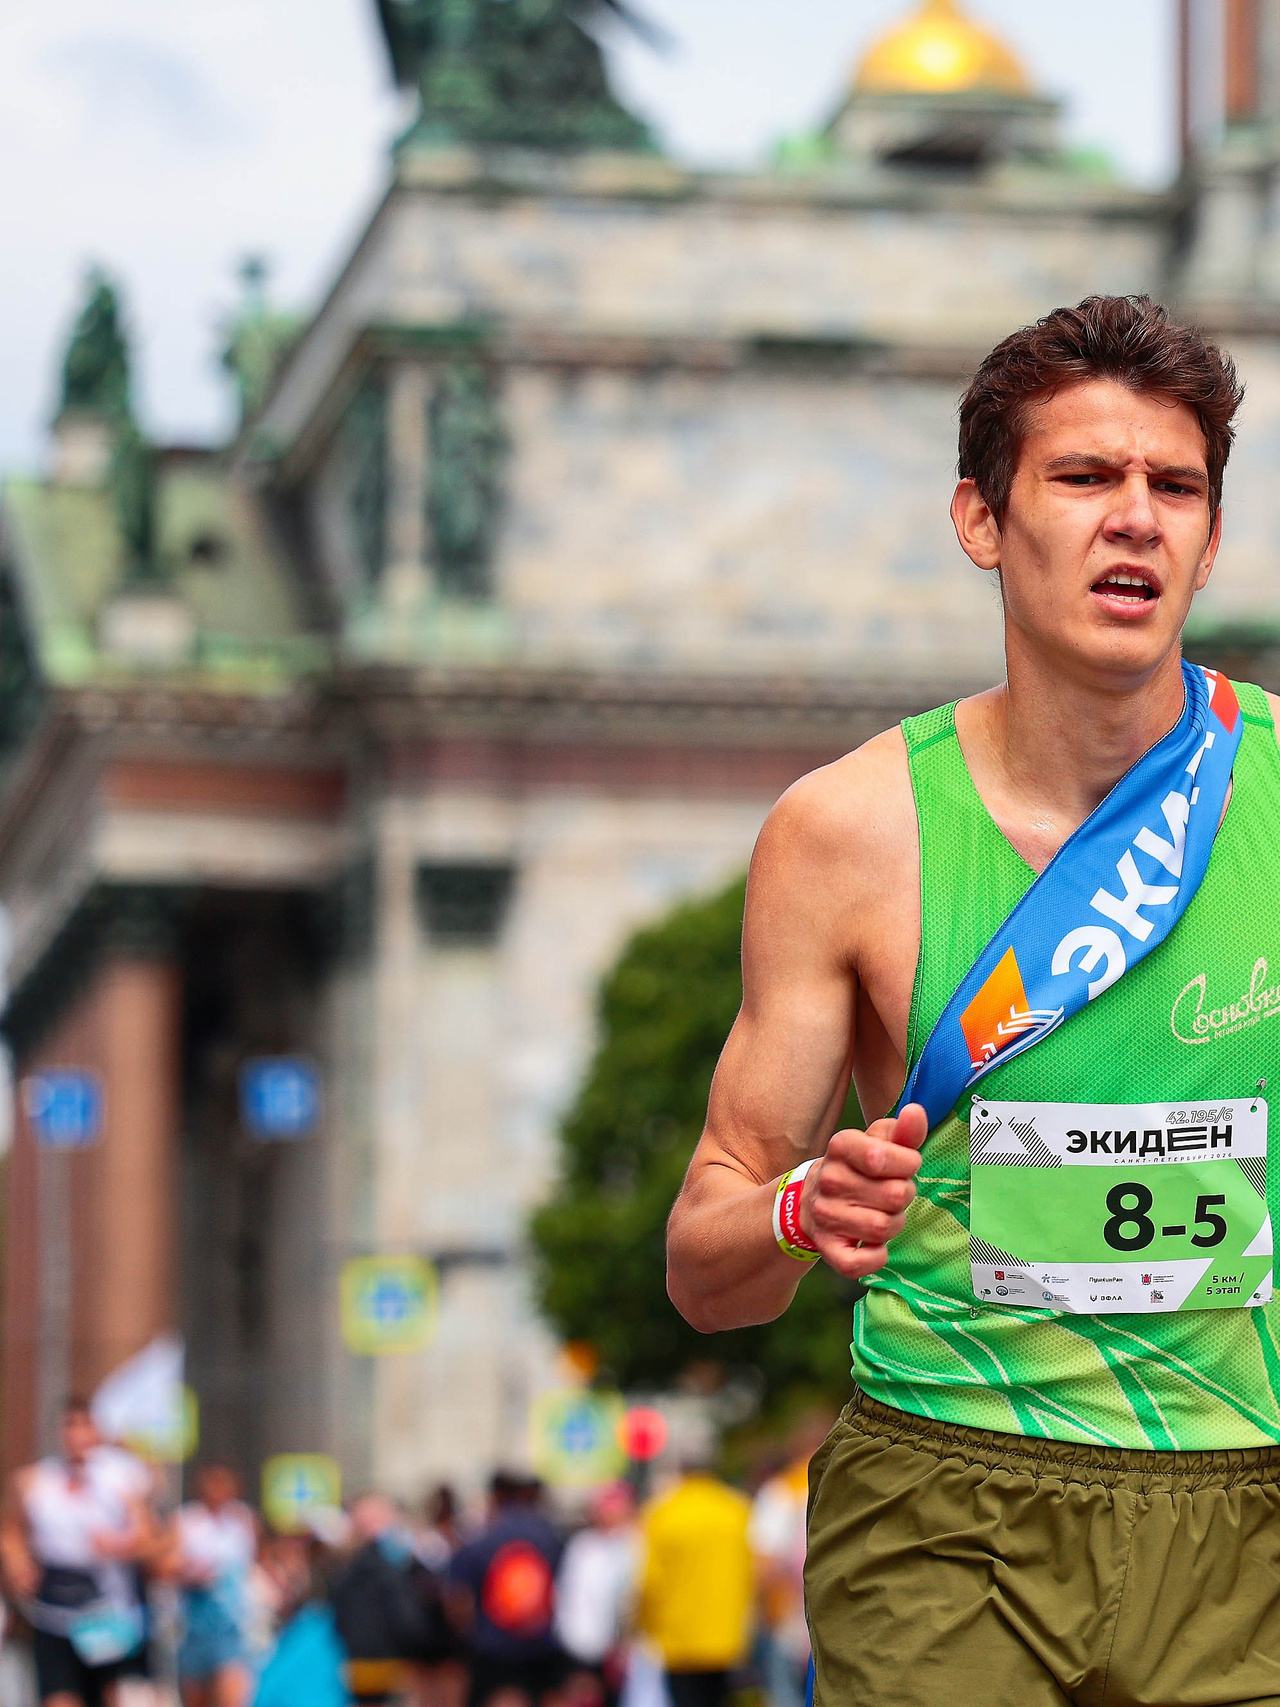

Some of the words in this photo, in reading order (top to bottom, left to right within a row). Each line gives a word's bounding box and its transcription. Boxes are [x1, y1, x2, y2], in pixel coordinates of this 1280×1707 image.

[1051, 730, 1214, 1002] ЭКИ
[1165, 1106, 1234, 1125] 42.195/6
[1065, 1124, 1233, 1158] ЭКИДЕН
[1114, 1154, 1208, 1164] САНКТ-ПЕТЕРБУРГ
[1103, 1181, 1228, 1252] 8-5
[1212, 1275, 1219, 1284] 5
[1221, 1275, 1237, 1283] км
[1206, 1286, 1213, 1295] 5
[1215, 1286, 1241, 1294] этап
